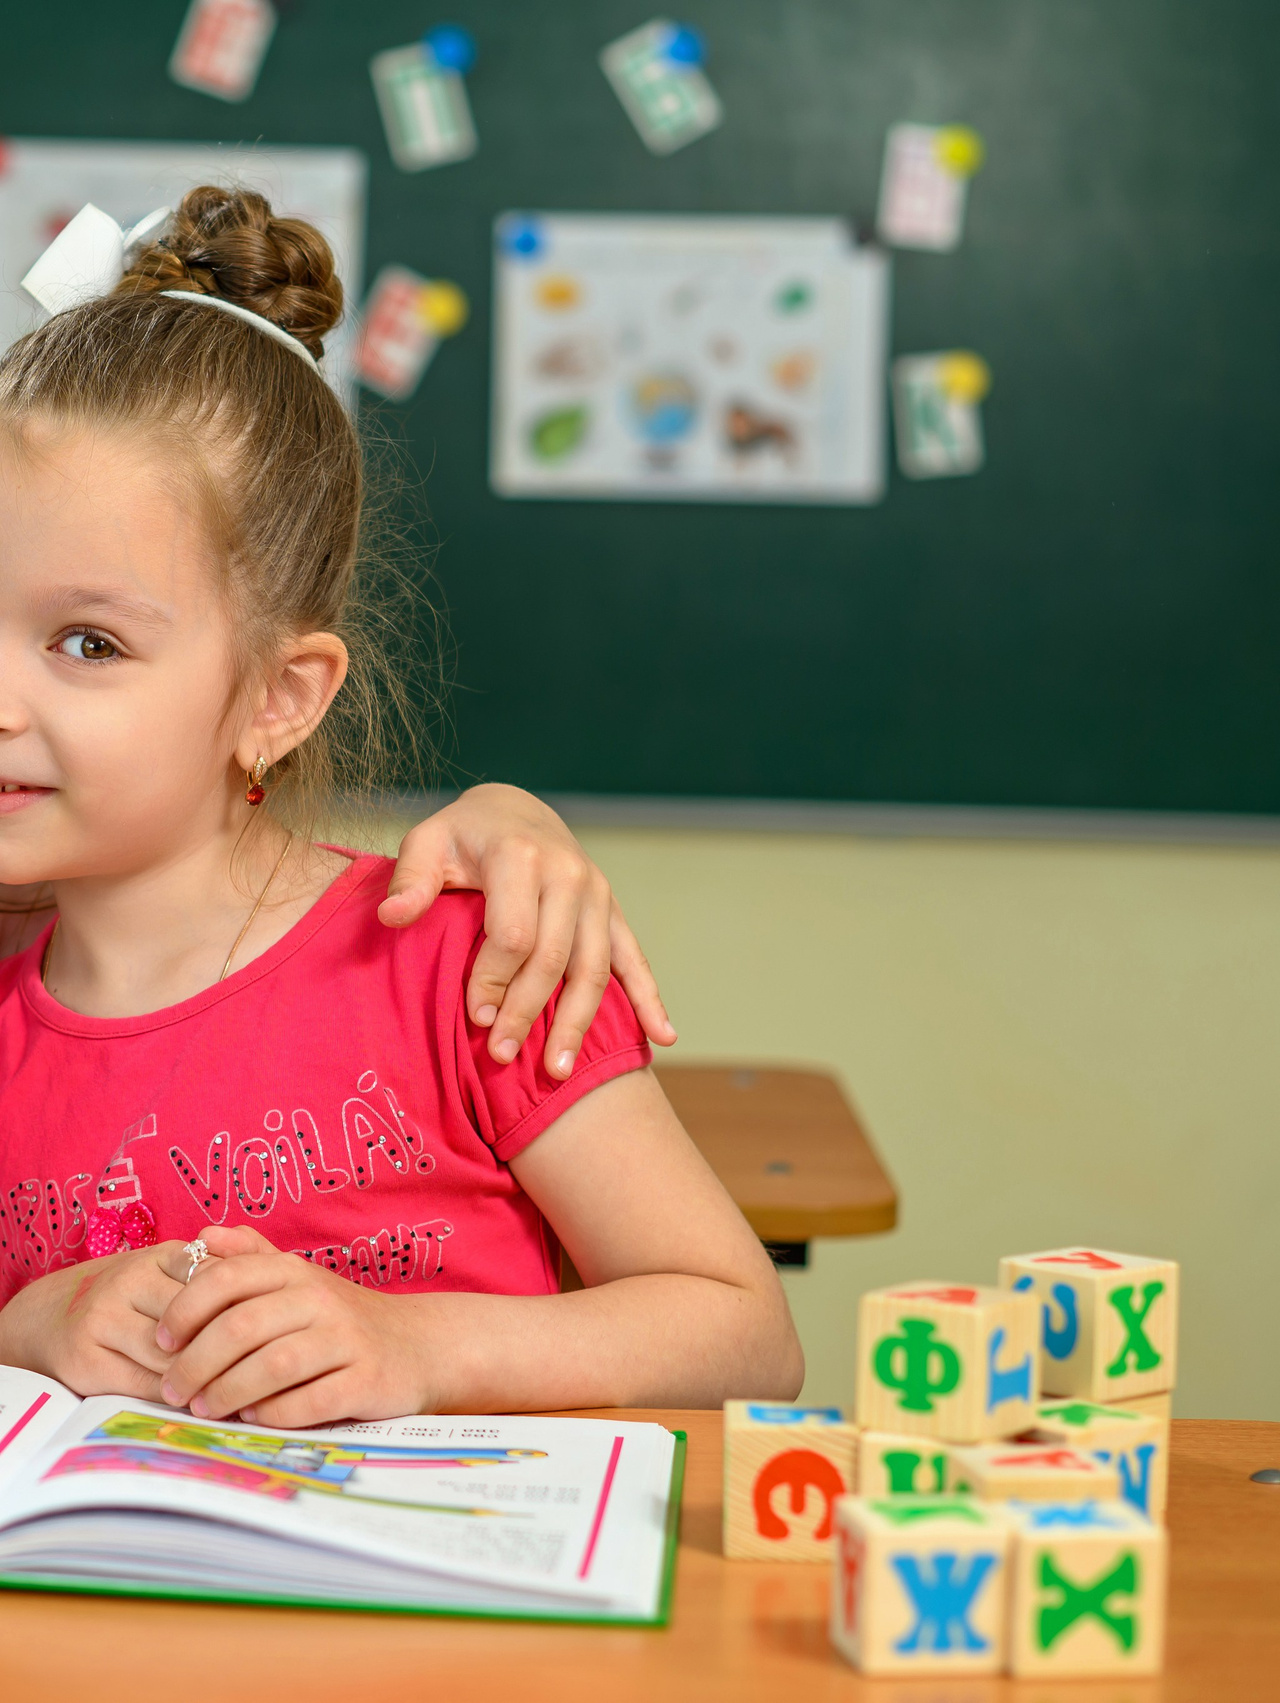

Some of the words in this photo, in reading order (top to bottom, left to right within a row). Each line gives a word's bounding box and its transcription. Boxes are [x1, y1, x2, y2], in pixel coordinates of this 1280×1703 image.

[873, 1317, 962, 1414] Ф
[1105, 1281, 1165, 1378] Х
[889, 1551, 1000, 1655] Ж
